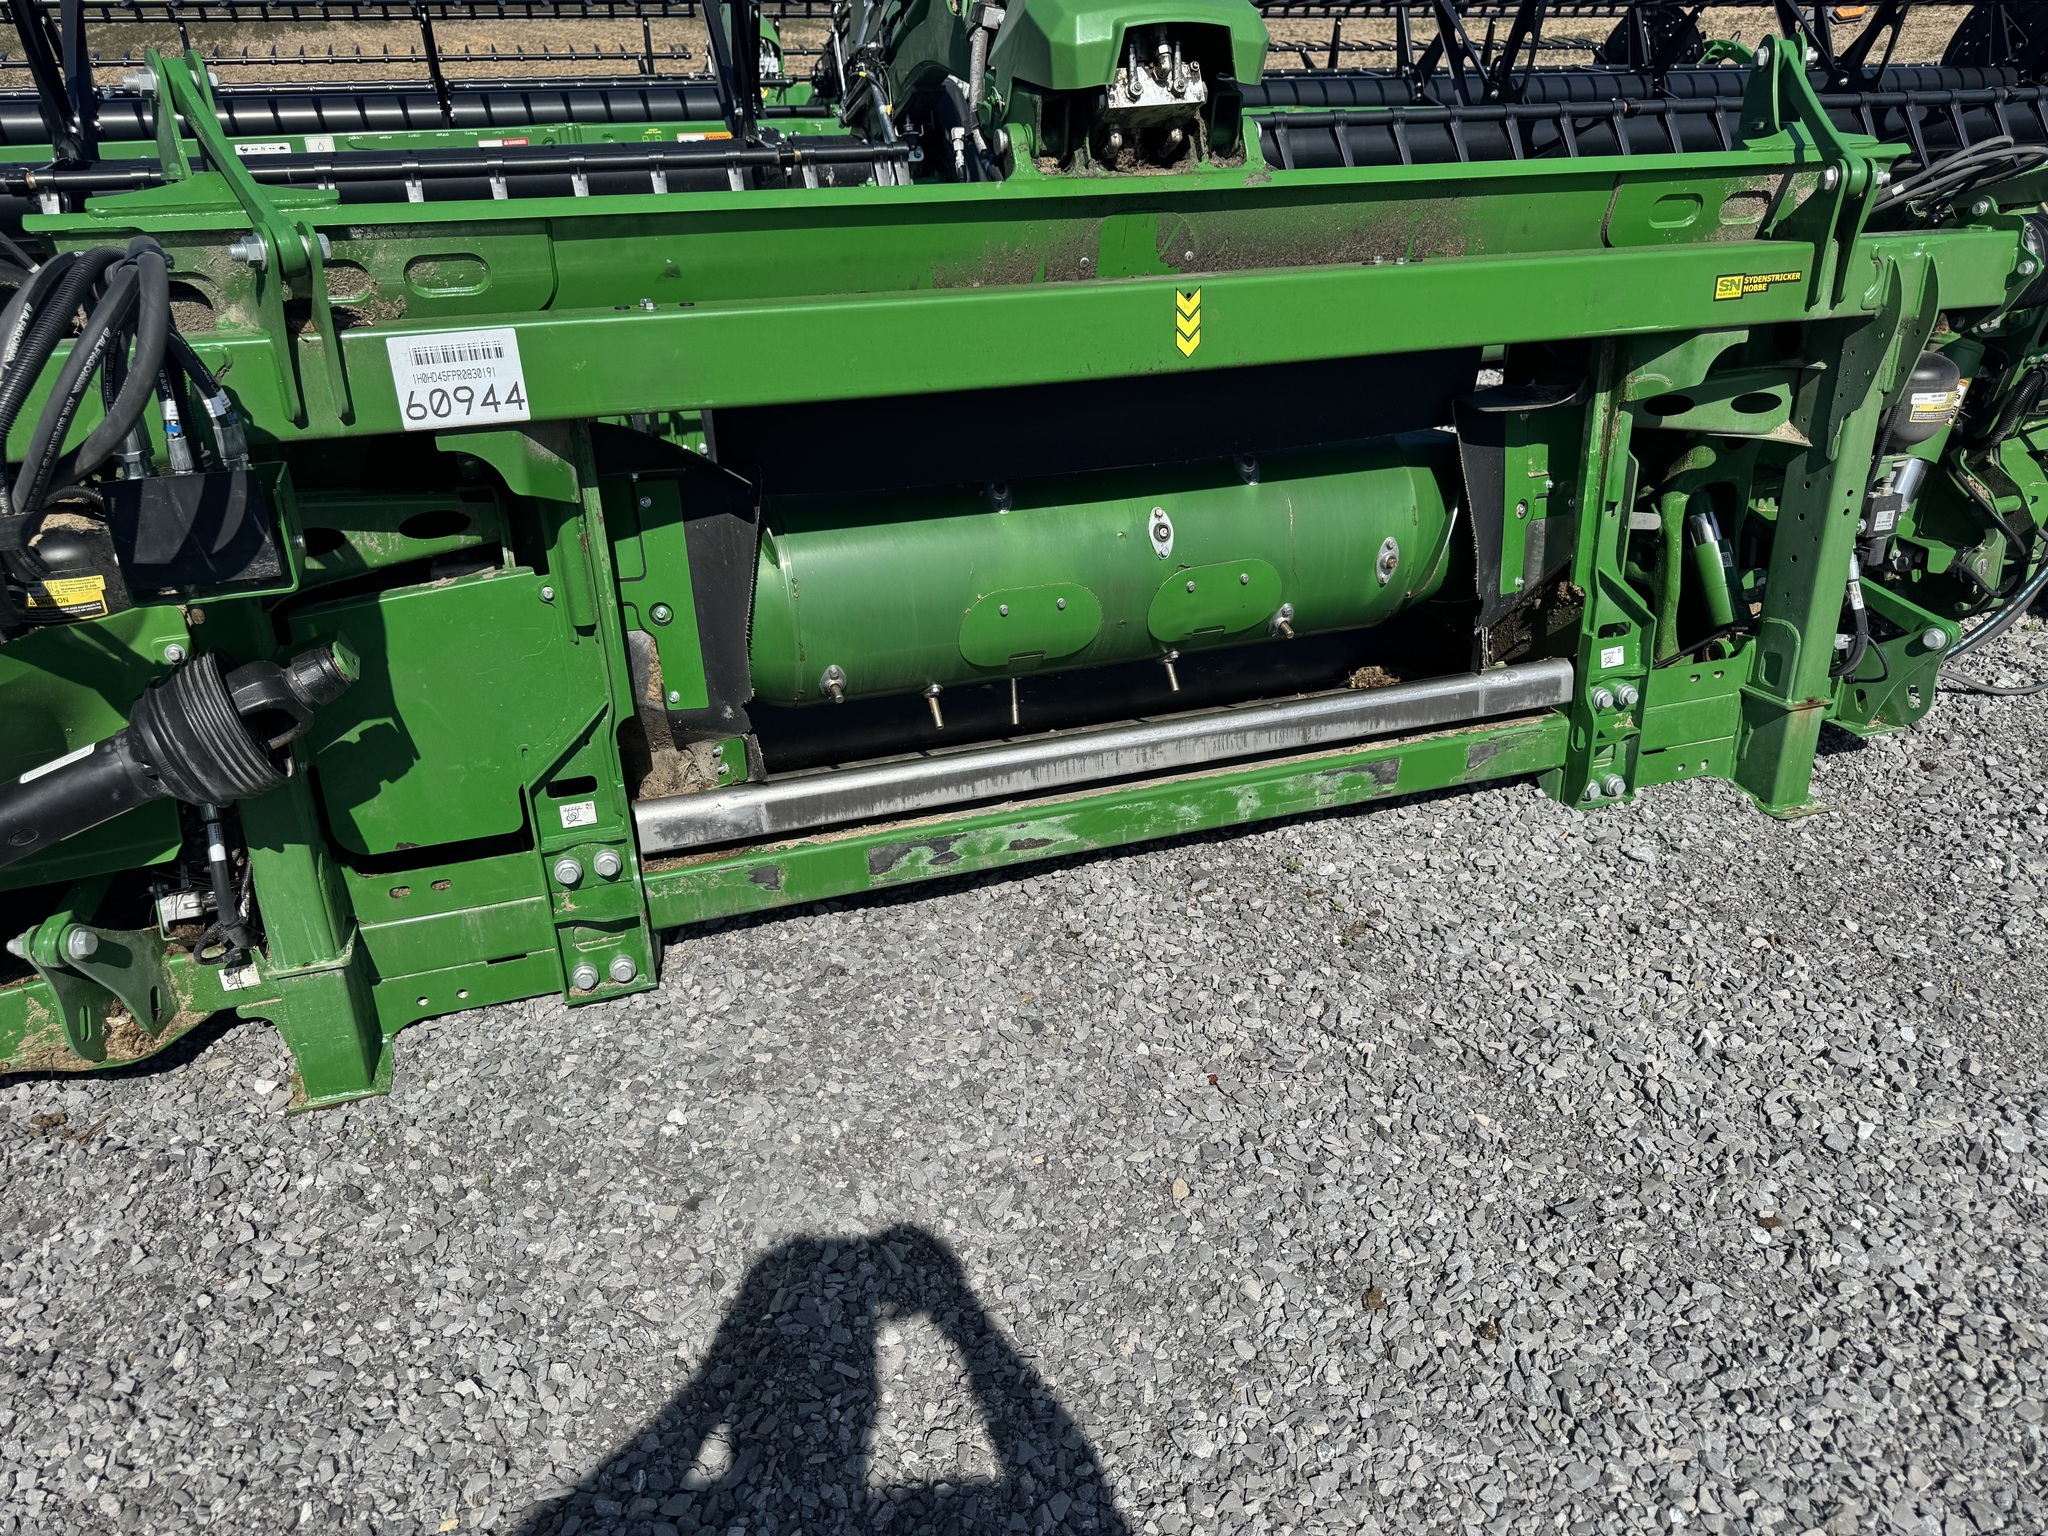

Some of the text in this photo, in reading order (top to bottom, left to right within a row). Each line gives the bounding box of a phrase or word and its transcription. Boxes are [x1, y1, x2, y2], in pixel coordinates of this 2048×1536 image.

[1743, 283, 1767, 292] NOBBE
[1744, 272, 1801, 284] SYDENSTRICKER
[5, 309, 33, 362] ALFAGOMMA
[71, 334, 108, 393] ALFAGOMMA
[61, 396, 76, 416] AT4K
[405, 380, 526, 421] 60944
[36, 597, 69, 606] CAUTION
